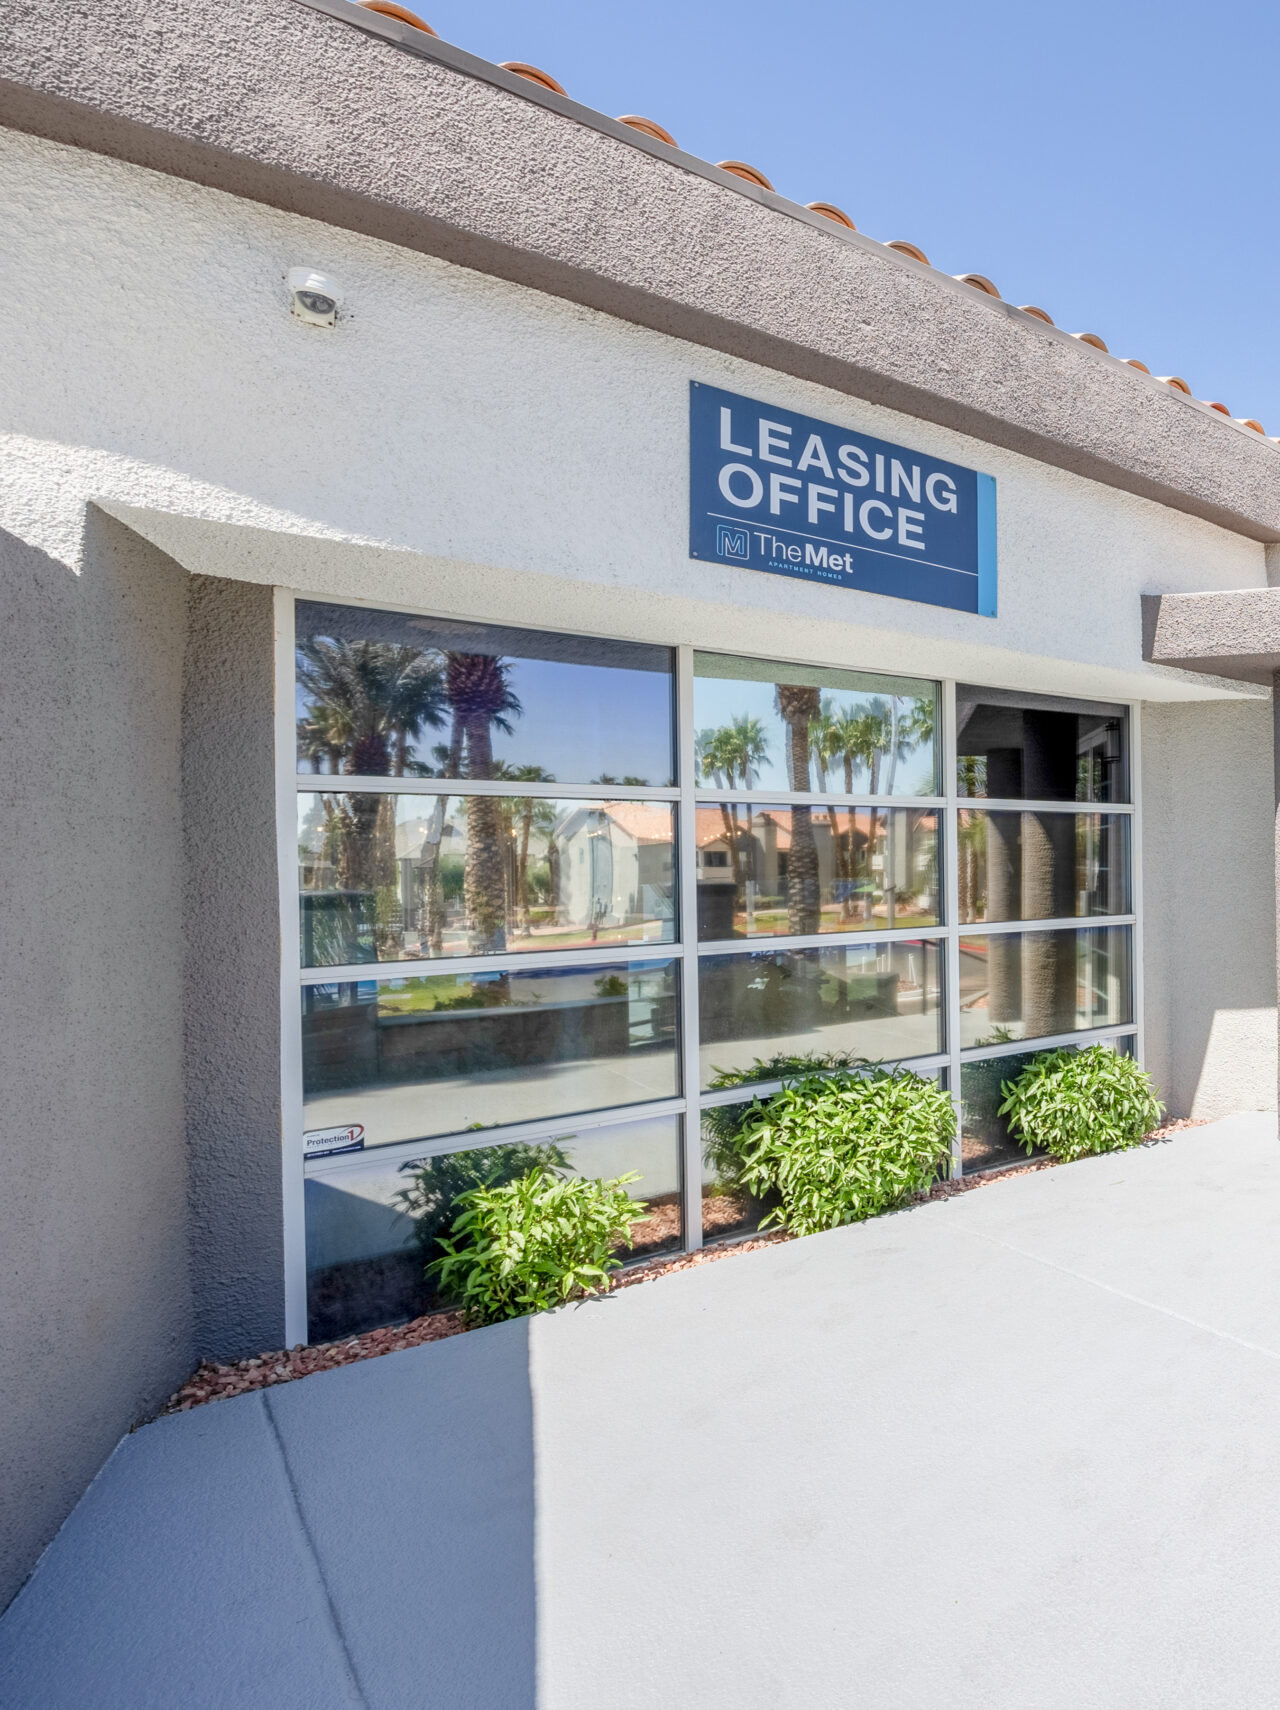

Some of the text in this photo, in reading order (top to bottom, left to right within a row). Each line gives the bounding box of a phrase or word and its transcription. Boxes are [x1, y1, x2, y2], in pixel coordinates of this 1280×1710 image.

[720, 406, 958, 514] LEASING
[718, 462, 926, 550] OFFICE
[769, 561, 843, 580] APARTMENT HOMES
